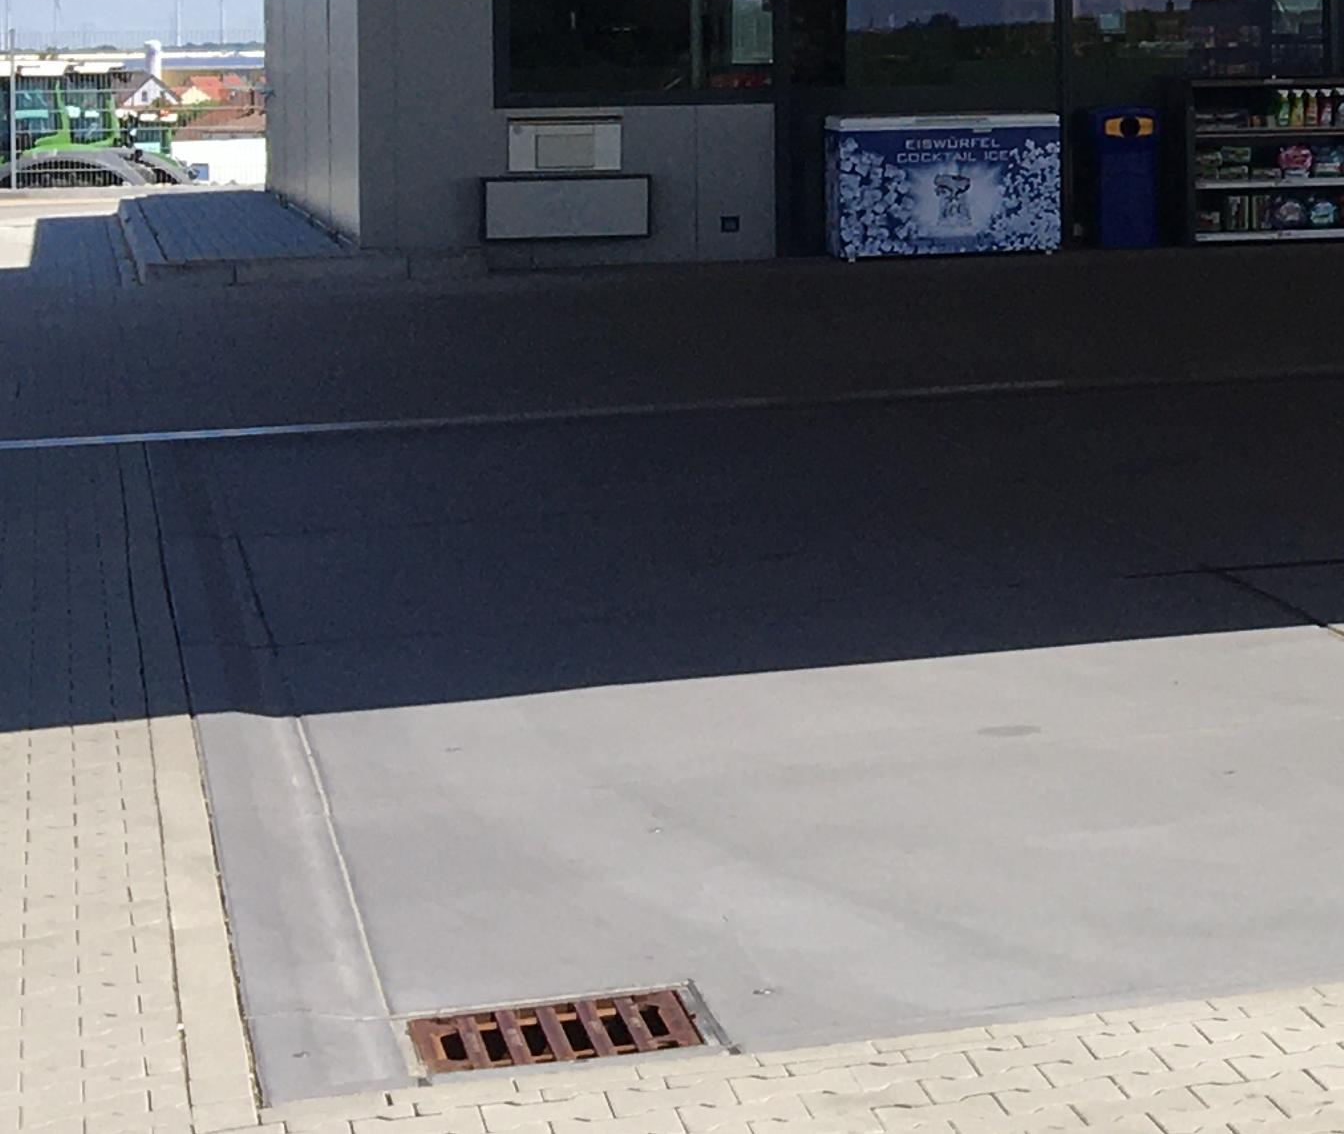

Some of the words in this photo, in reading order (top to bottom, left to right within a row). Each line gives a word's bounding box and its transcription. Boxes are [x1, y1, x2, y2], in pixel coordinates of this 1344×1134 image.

[904, 137, 1001, 150] EISWÜRFEL
[896, 150, 977, 164] COCKTAIL
[983, 149, 1009, 162] ICE
